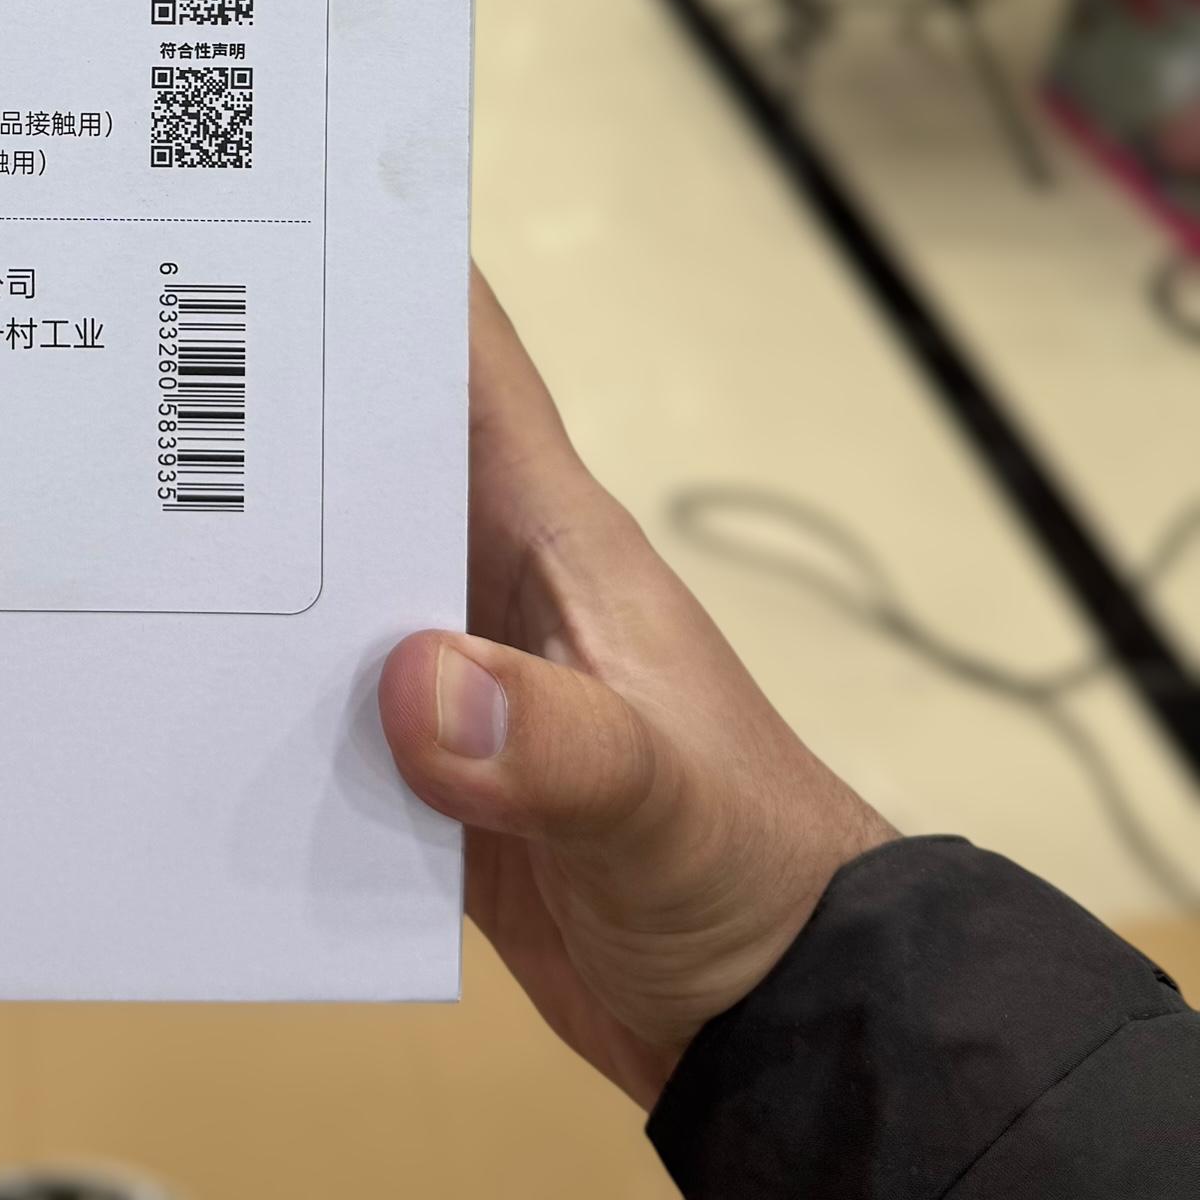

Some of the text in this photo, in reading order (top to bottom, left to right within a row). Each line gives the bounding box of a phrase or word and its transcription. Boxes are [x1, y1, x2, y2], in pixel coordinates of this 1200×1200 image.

[159, 41, 246, 60] 符合性声明
